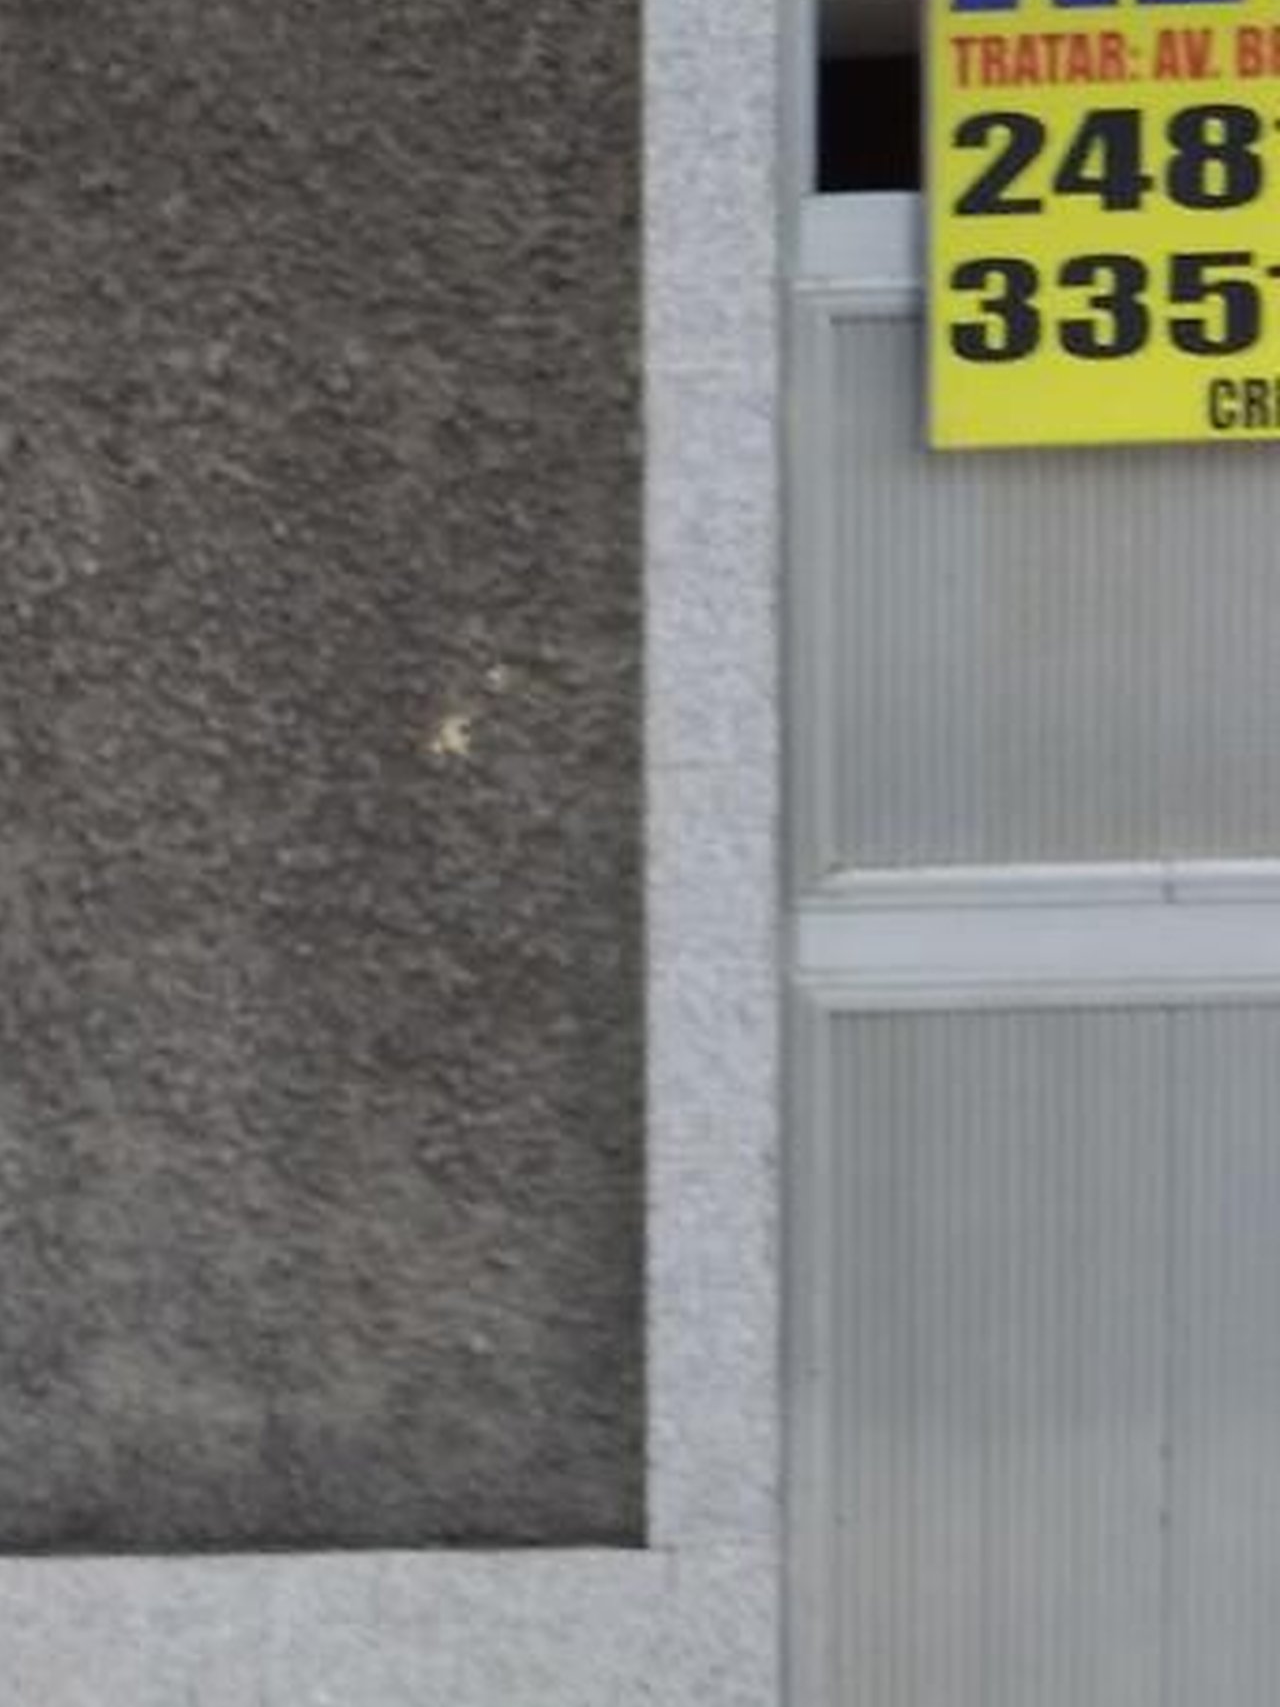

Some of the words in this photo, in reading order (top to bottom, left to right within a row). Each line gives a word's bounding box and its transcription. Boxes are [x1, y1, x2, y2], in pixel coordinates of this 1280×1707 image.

[951, 29, 1140, 89] TRATAR:
[1155, 28, 1221, 80] AV.
[951, 104, 1280, 216] 248
[949, 251, 1280, 363] 335
[1208, 377, 1280, 430] CR
